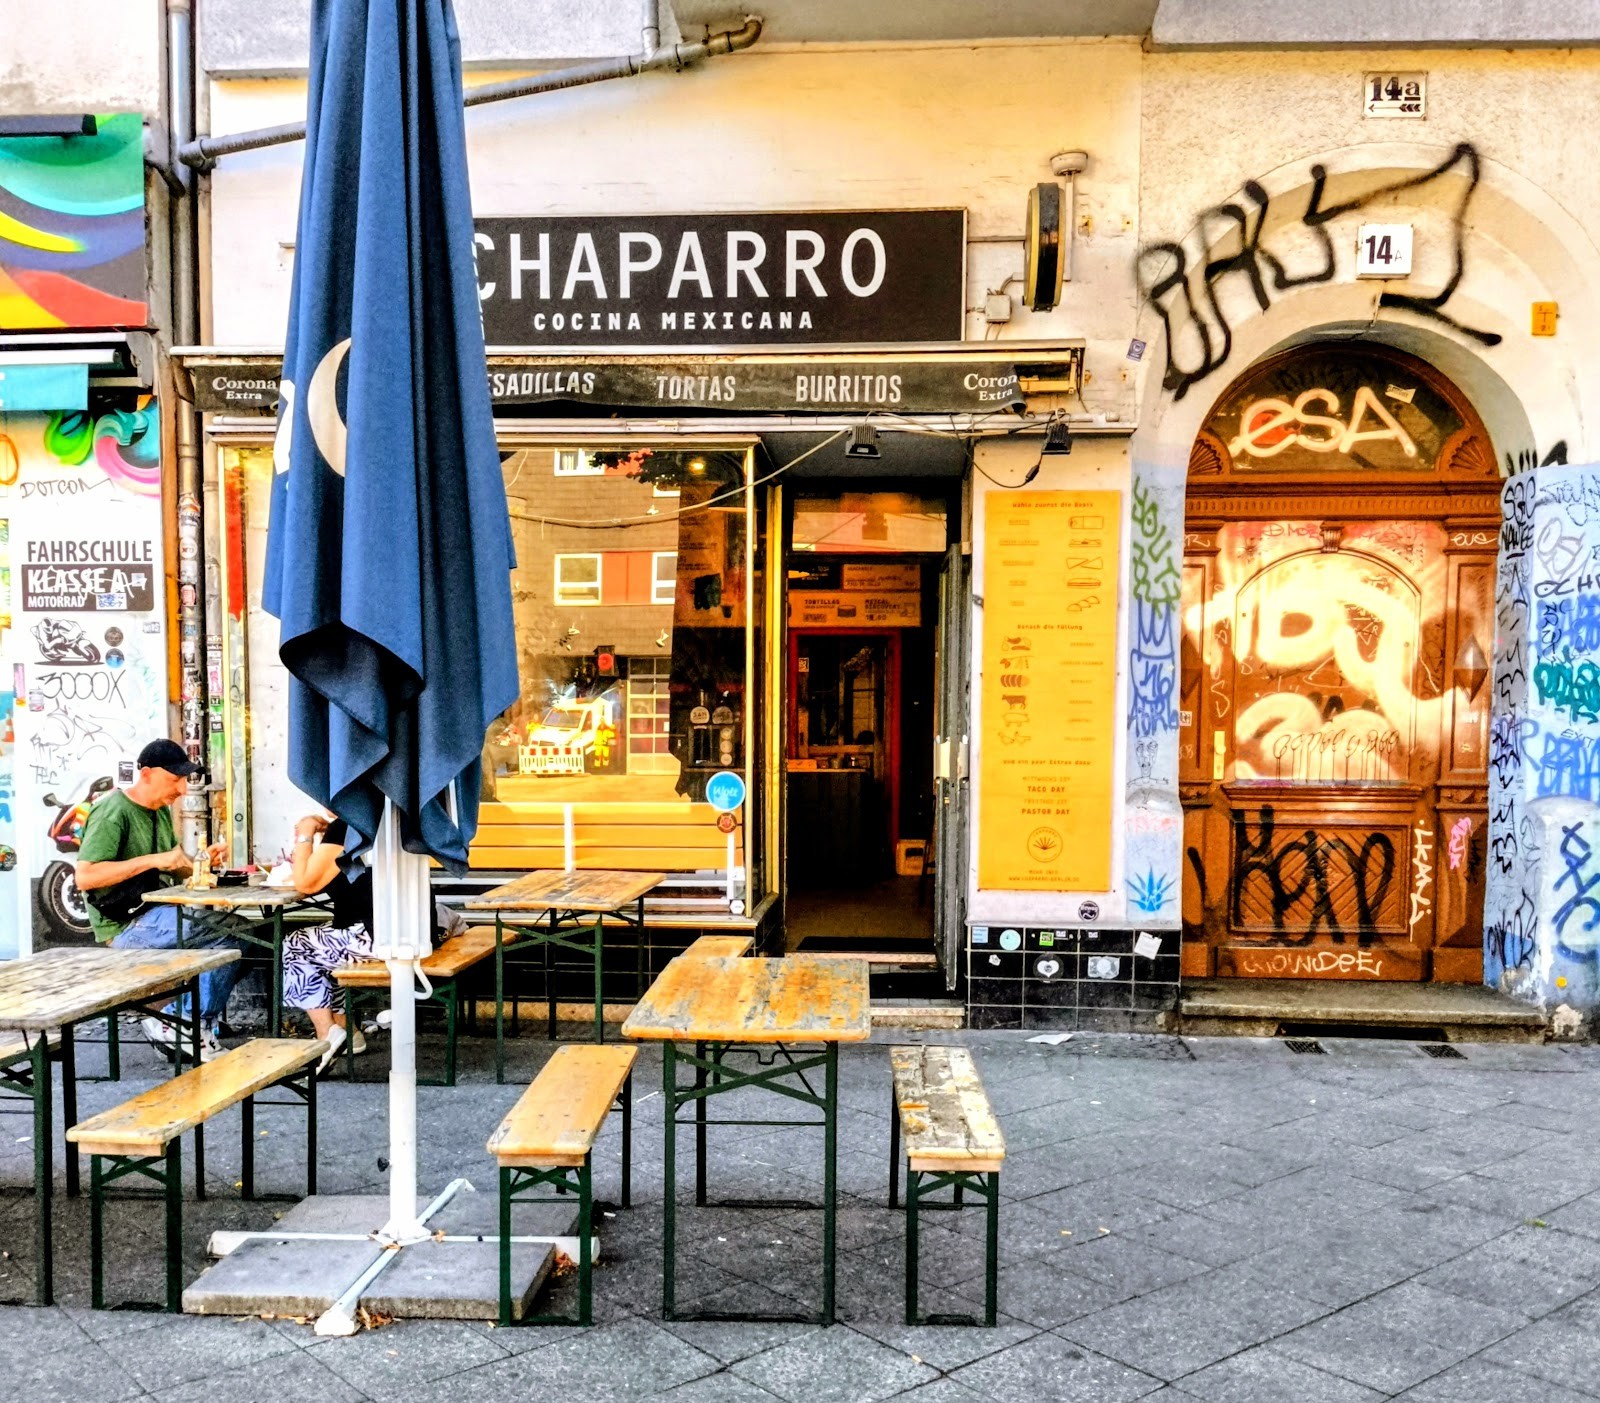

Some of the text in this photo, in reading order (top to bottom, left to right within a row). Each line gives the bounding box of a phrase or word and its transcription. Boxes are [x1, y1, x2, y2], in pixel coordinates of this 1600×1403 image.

[1370, 76, 1420, 101] 14a
[1365, 235, 1393, 265] 14
[474, 228, 887, 301] CHAPARRO
[533, 310, 814, 332] COCINA MEXICANA
[212, 376, 278, 391] Corona
[656, 375, 737, 402] TORTAS
[795, 374, 902, 403] BURRITOS
[963, 373, 1018, 390] Coron
[225, 390, 263, 401] Extra
[978, 388, 1013, 401] Extra
[27, 540, 153, 562] FAHRSCHULE
[27, 567, 126, 594] KLASSE A
[27, 596, 85, 608] MOTORRAD
[1027, 785, 1066, 793] TACO DAY
[1021, 807, 1052, 815] PASTOR
